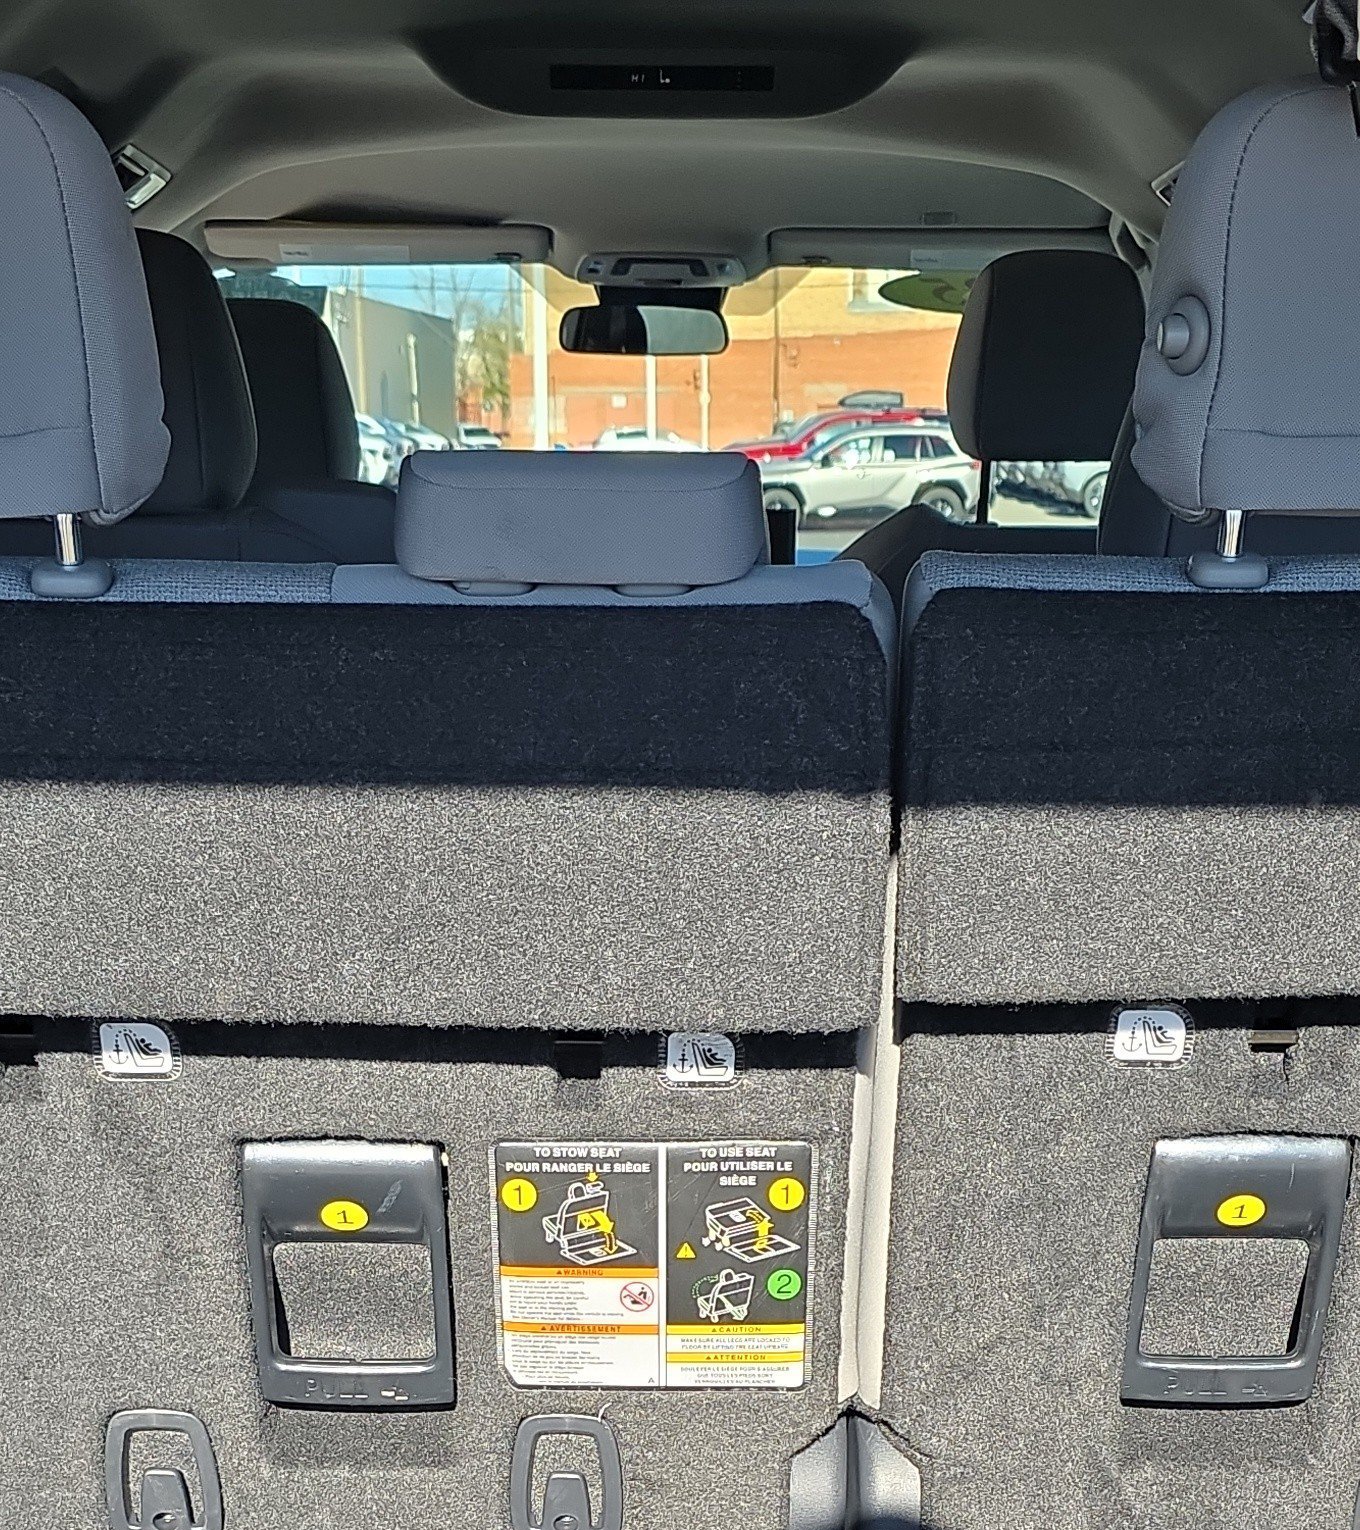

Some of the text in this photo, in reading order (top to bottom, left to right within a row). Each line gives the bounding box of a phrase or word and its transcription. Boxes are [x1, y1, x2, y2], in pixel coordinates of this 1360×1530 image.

[533, 1147, 623, 1158] TO STOW SEAT
[700, 1147, 777, 1158] TO USE SEAT
[505, 1161, 651, 1173] POUR RANGER LE SIÈGE
[683, 1161, 793, 1171] POUR UTILISER LE
[719, 1173, 757, 1186] SIÈGE
[513, 1184, 522, 1205] 1
[781, 1184, 790, 1205] 1
[336, 1209, 354, 1224] 1
[1231, 1204, 1248, 1219] 1
[776, 1274, 792, 1294] 2
